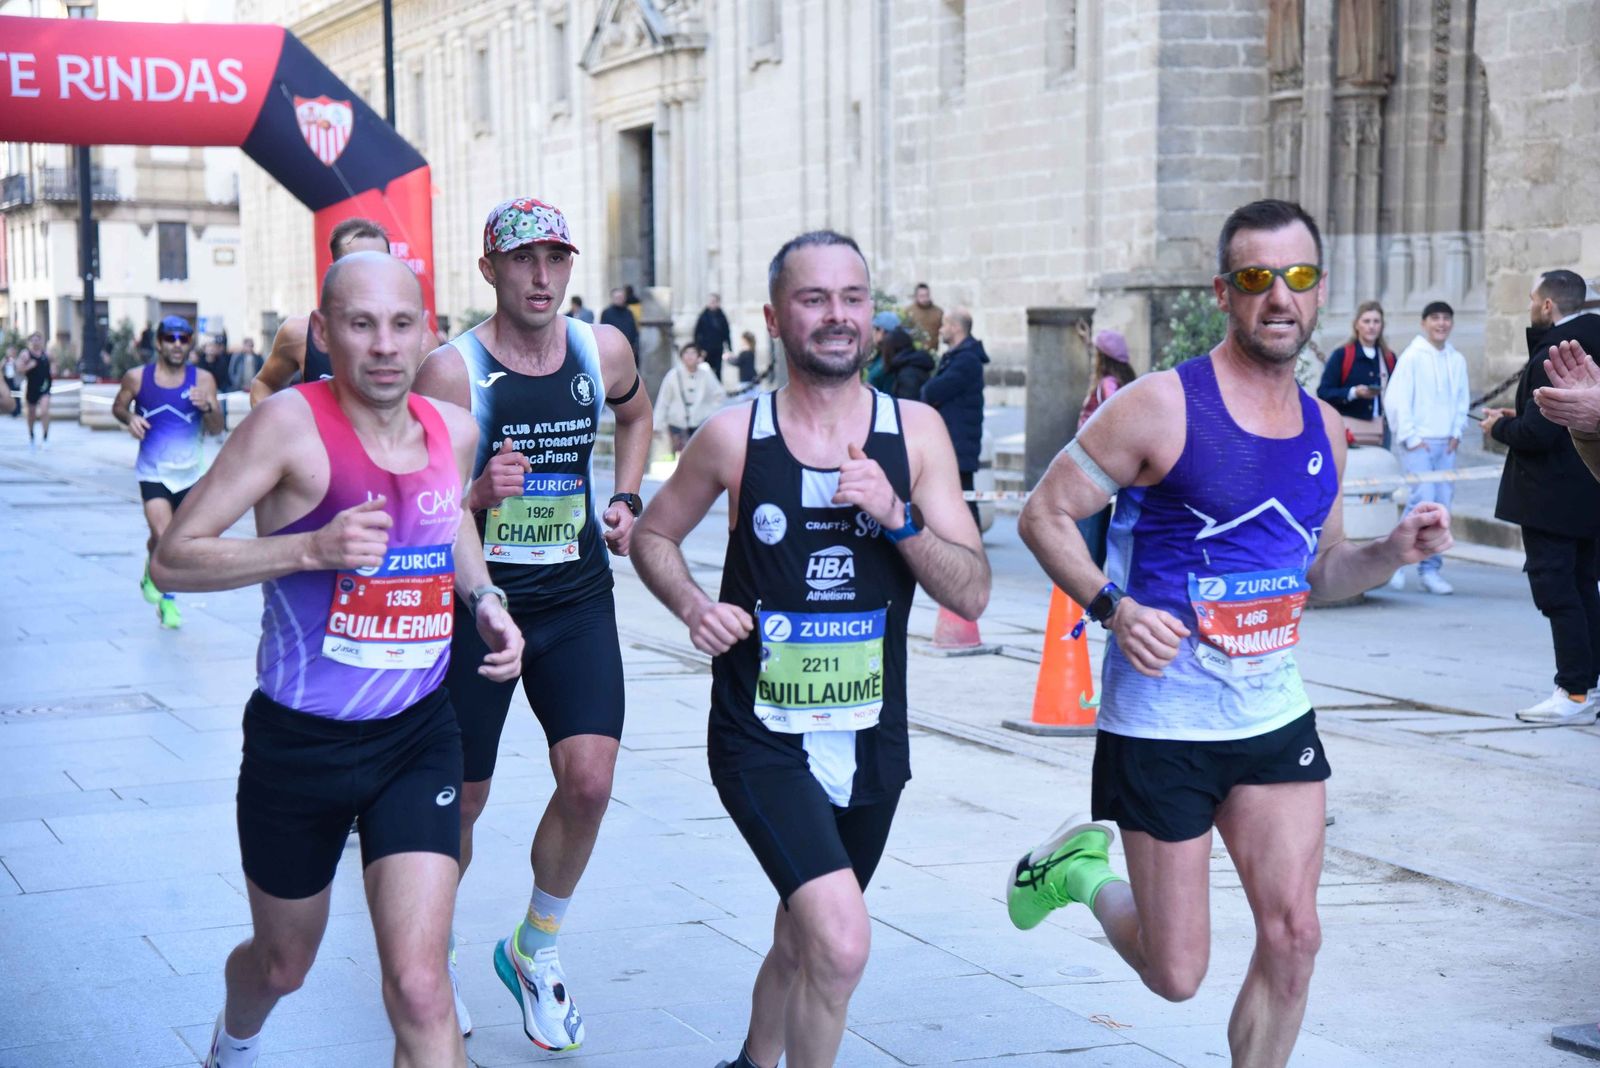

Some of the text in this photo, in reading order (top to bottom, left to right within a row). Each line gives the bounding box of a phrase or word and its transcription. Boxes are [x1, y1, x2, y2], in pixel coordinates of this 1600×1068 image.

[57, 54, 247, 105] RINDAS
[502, 417, 591, 435] CLUB ATLETISMO
[492, 439, 535, 451] PRTO
[525, 479, 578, 493] ZURICH
[526, 507, 554, 519] 1926
[497, 522, 576, 543] CHANITO
[805, 521, 840, 531] CRAFT
[388, 552, 446, 571] ZURICH
[806, 557, 856, 579] HBA
[1235, 575, 1299, 595] ZURICH
[385, 589, 422, 607] 1353
[806, 589, 856, 602] Athlétisme
[329, 611, 453, 639] GUILLERMO
[1235, 609, 1268, 628] 1466
[800, 619, 873, 637] ZURICH
[801, 657, 839, 672] 2211
